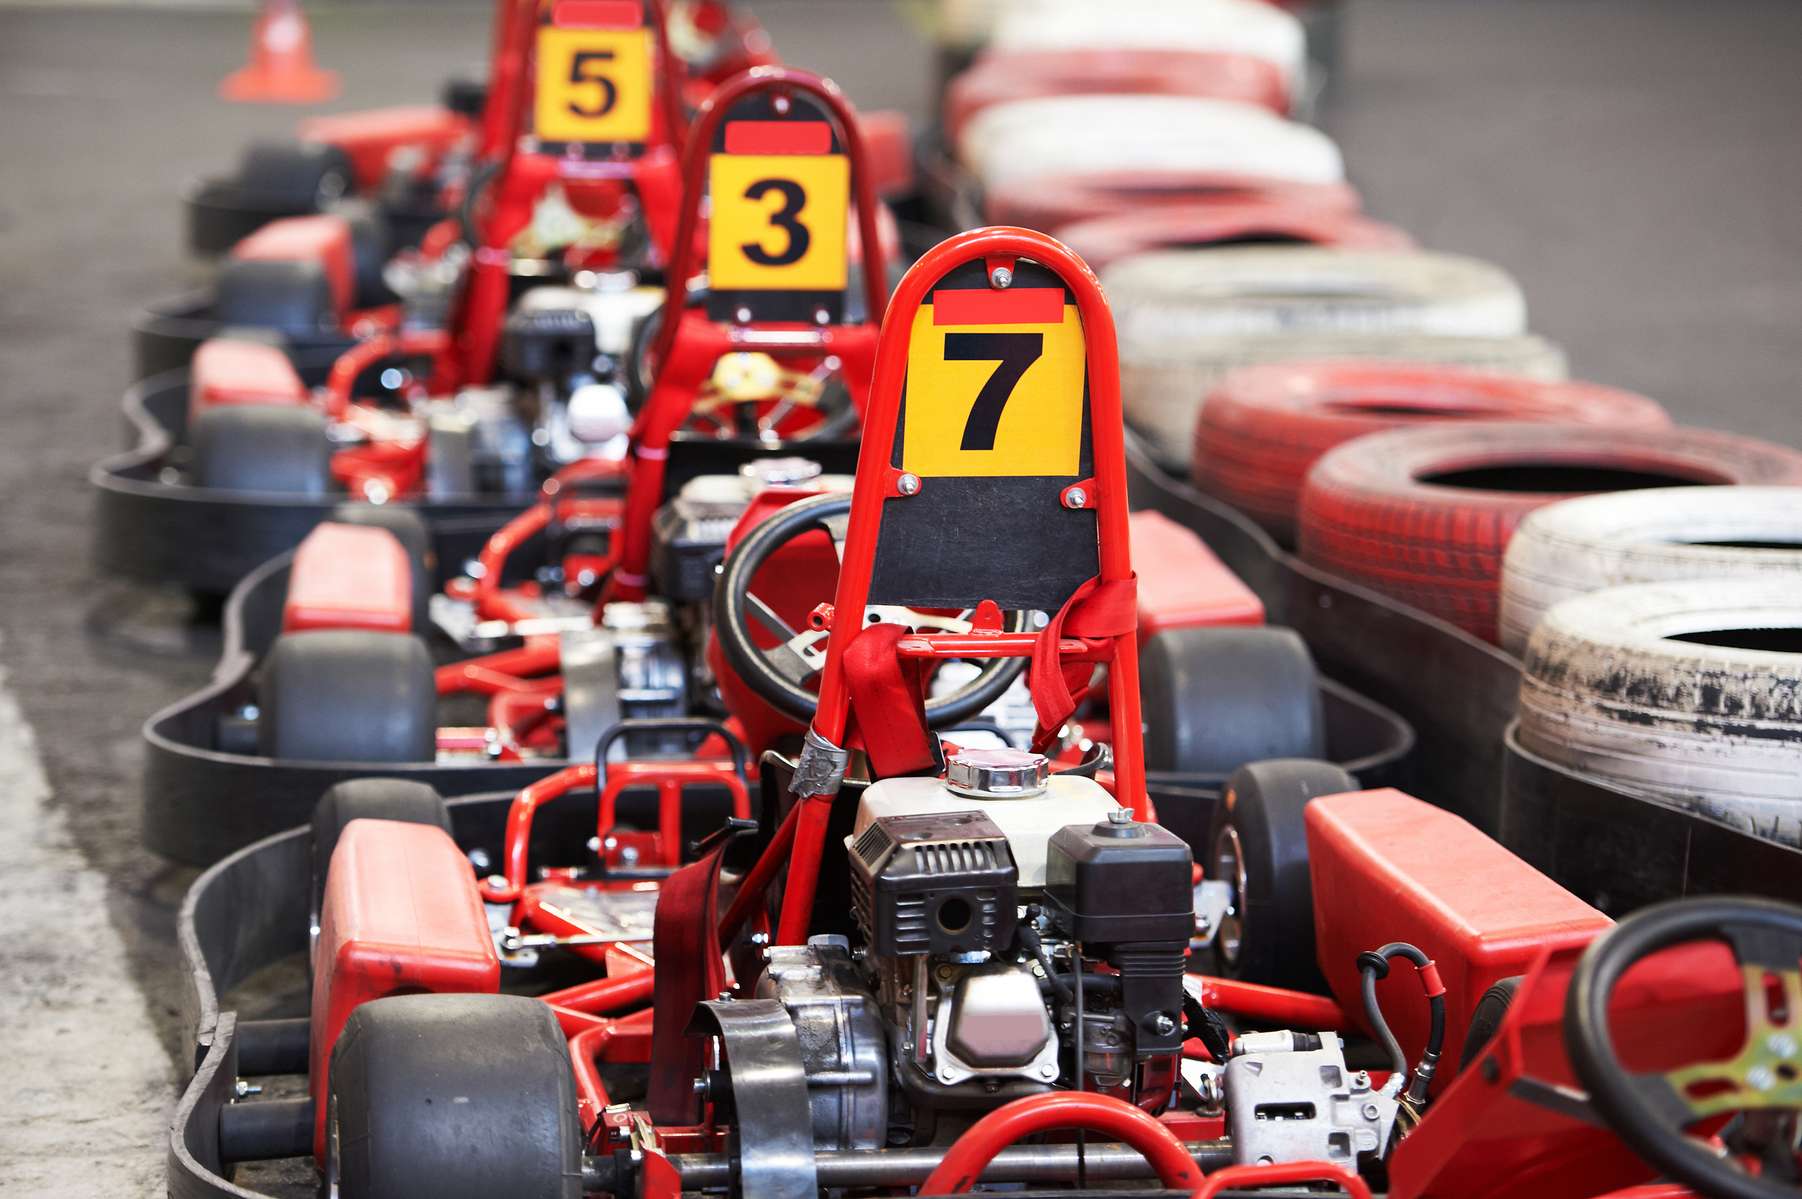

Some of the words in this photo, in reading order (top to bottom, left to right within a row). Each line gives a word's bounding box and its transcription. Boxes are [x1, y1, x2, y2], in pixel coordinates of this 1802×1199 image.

[567, 51, 618, 118] 5
[741, 178, 811, 266] 3
[944, 333, 1044, 450] 7
